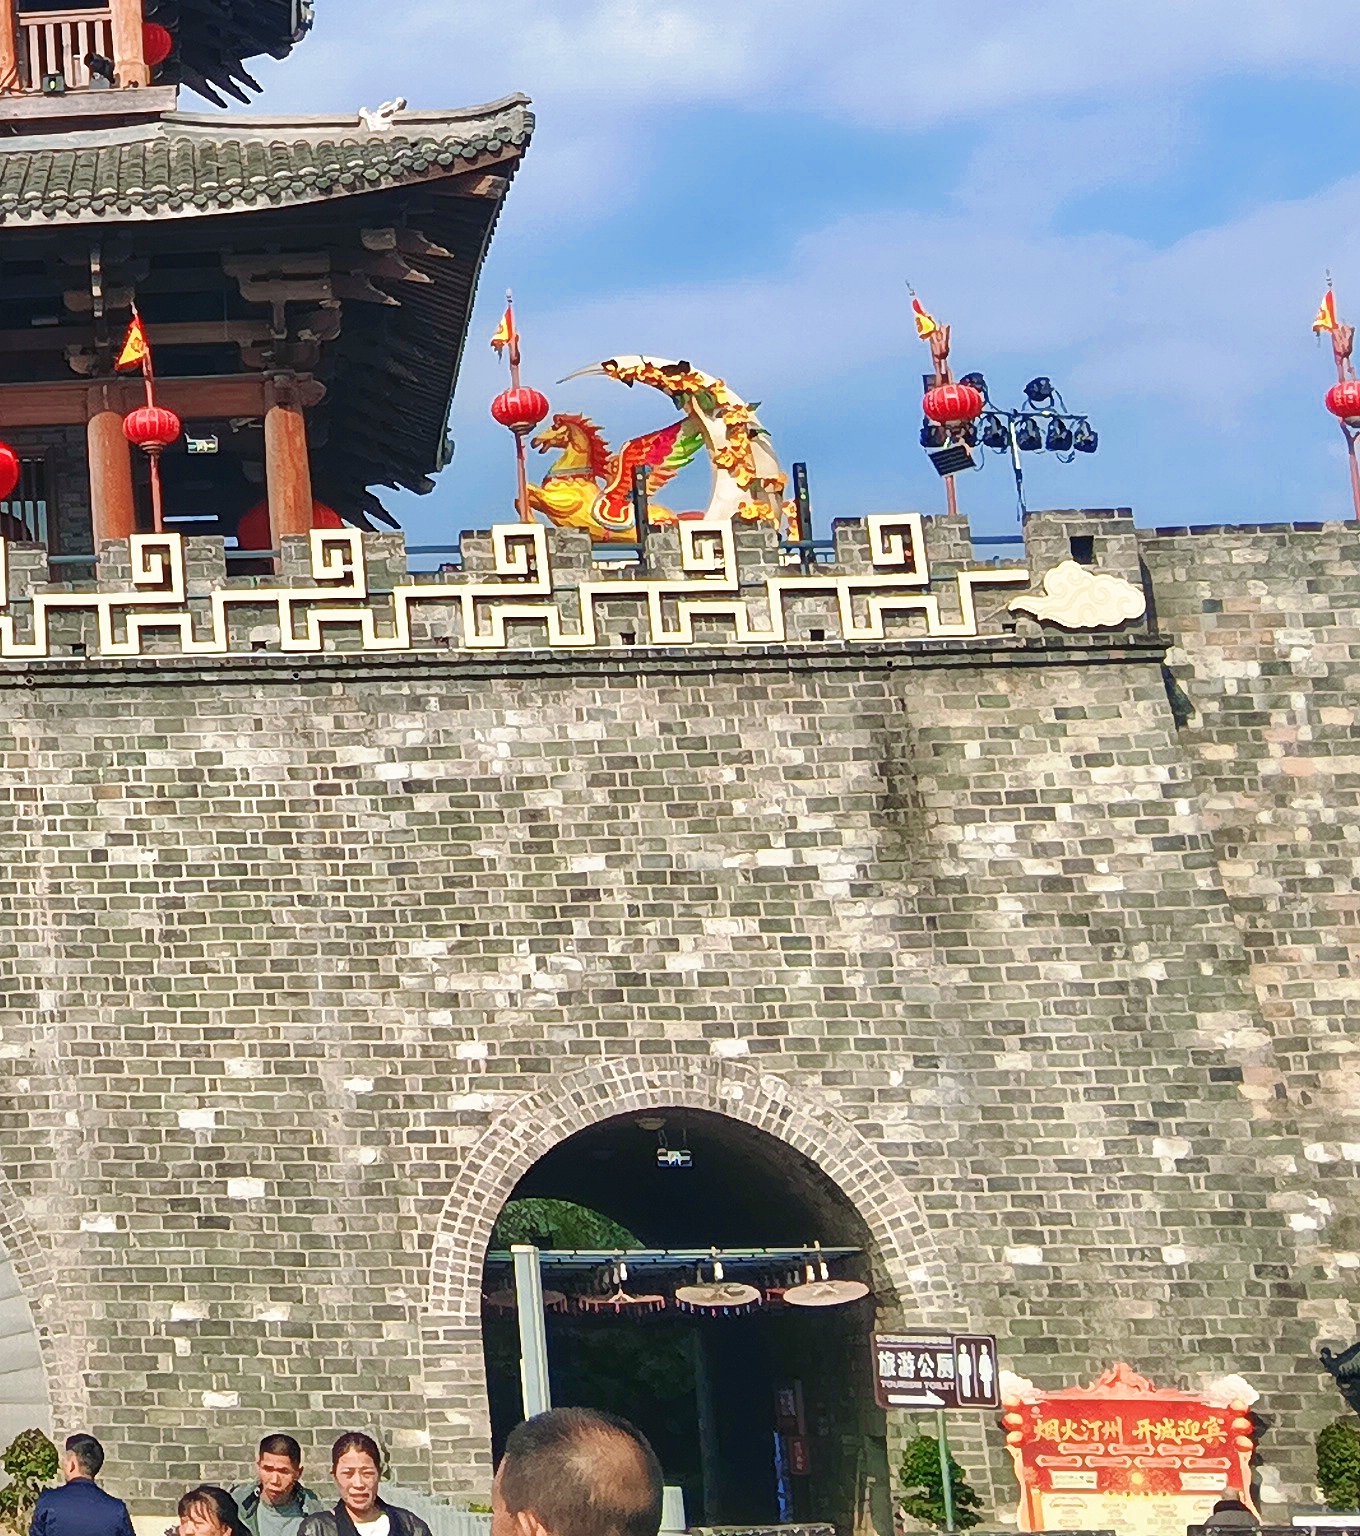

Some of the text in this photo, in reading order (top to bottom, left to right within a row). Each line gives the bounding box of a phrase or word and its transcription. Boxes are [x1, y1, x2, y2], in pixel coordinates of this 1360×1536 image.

[877, 1350, 955, 1379] 旅游公厕
[1034, 1415, 1228, 1445] 烟火汀州 开城迎宾
